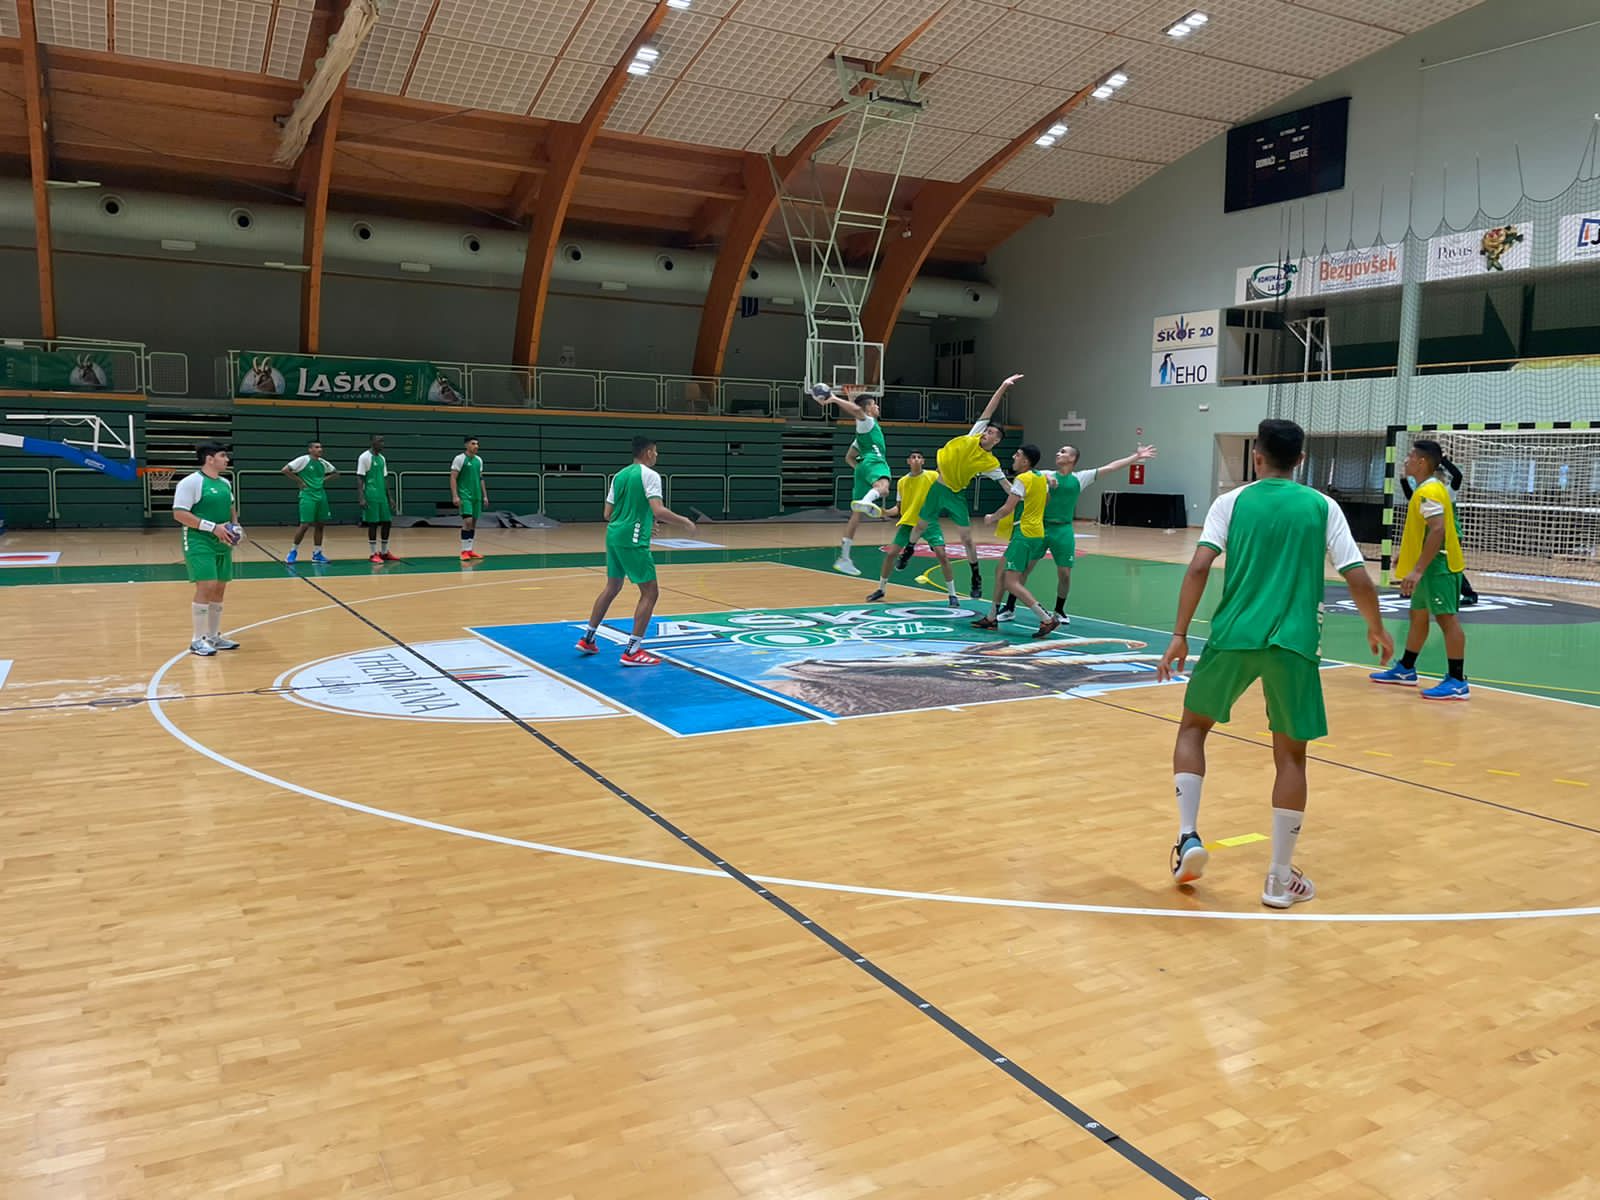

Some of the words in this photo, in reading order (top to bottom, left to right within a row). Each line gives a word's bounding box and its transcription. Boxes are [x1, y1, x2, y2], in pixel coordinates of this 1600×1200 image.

[1320, 251, 1397, 281] Bezgovšek
[1200, 326, 1214, 337] 20
[296, 367, 397, 397] LAŠKO
[1175, 365, 1208, 384] EHO
[349, 653, 461, 714] THERMANA
